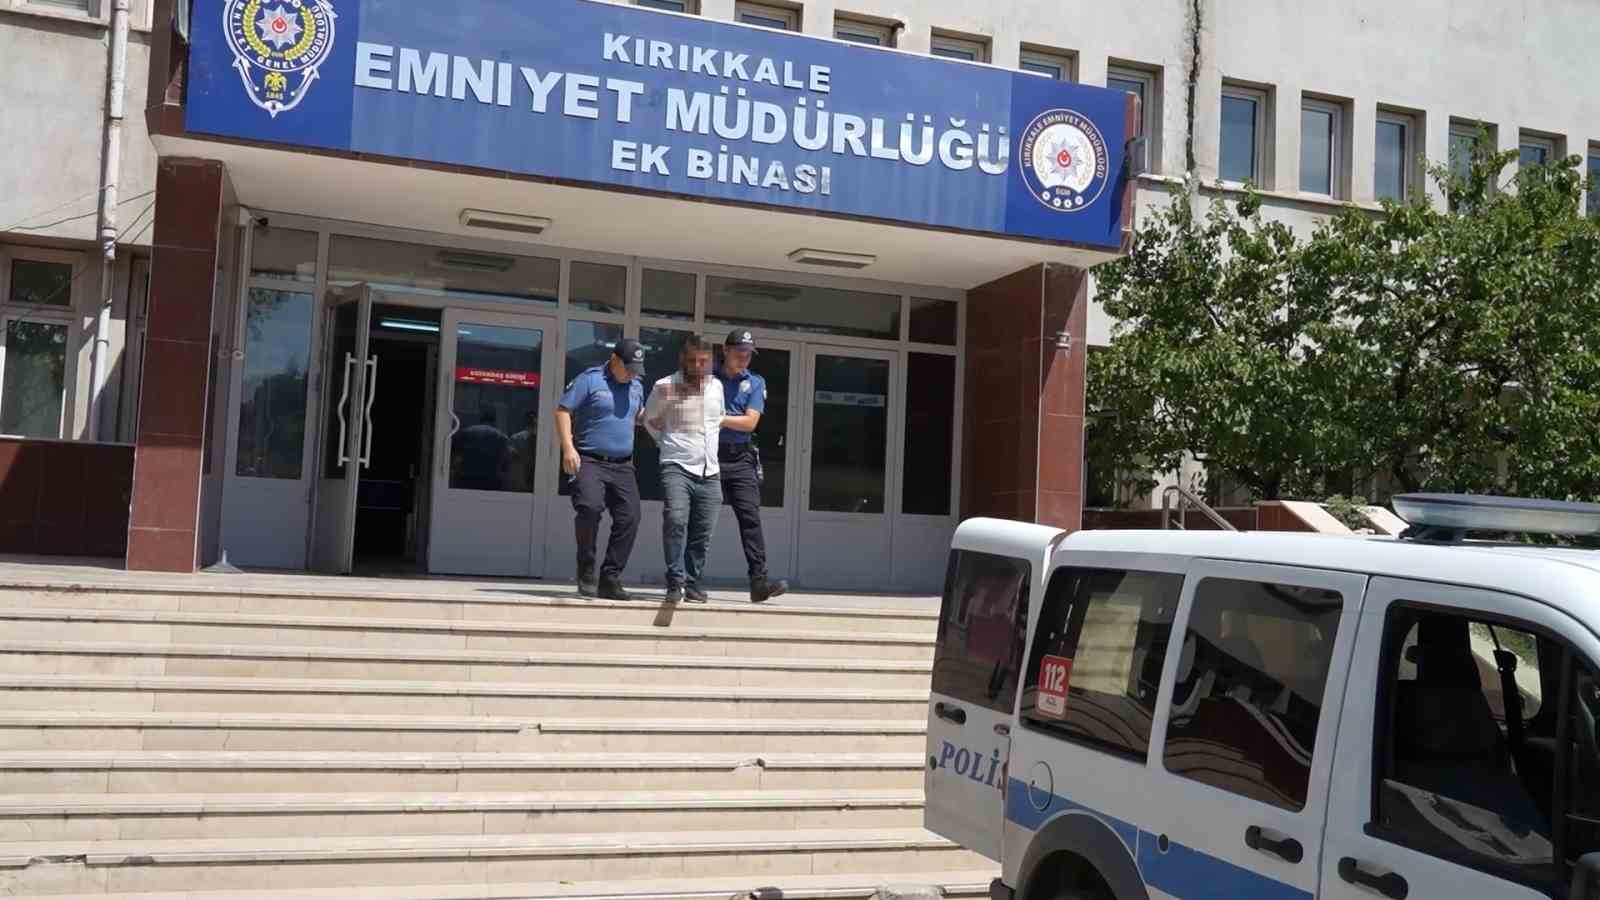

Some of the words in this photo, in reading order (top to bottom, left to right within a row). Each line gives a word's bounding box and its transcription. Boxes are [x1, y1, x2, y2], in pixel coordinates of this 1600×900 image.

[257, 56, 297, 69] GENEL
[603, 33, 830, 92] KIRIKKALE
[666, 86, 1010, 175] MÜDÜRLÜĞÜ
[612, 140, 671, 175] EK
[687, 145, 831, 195] BİNASI
[1045, 663, 1066, 692] 112
